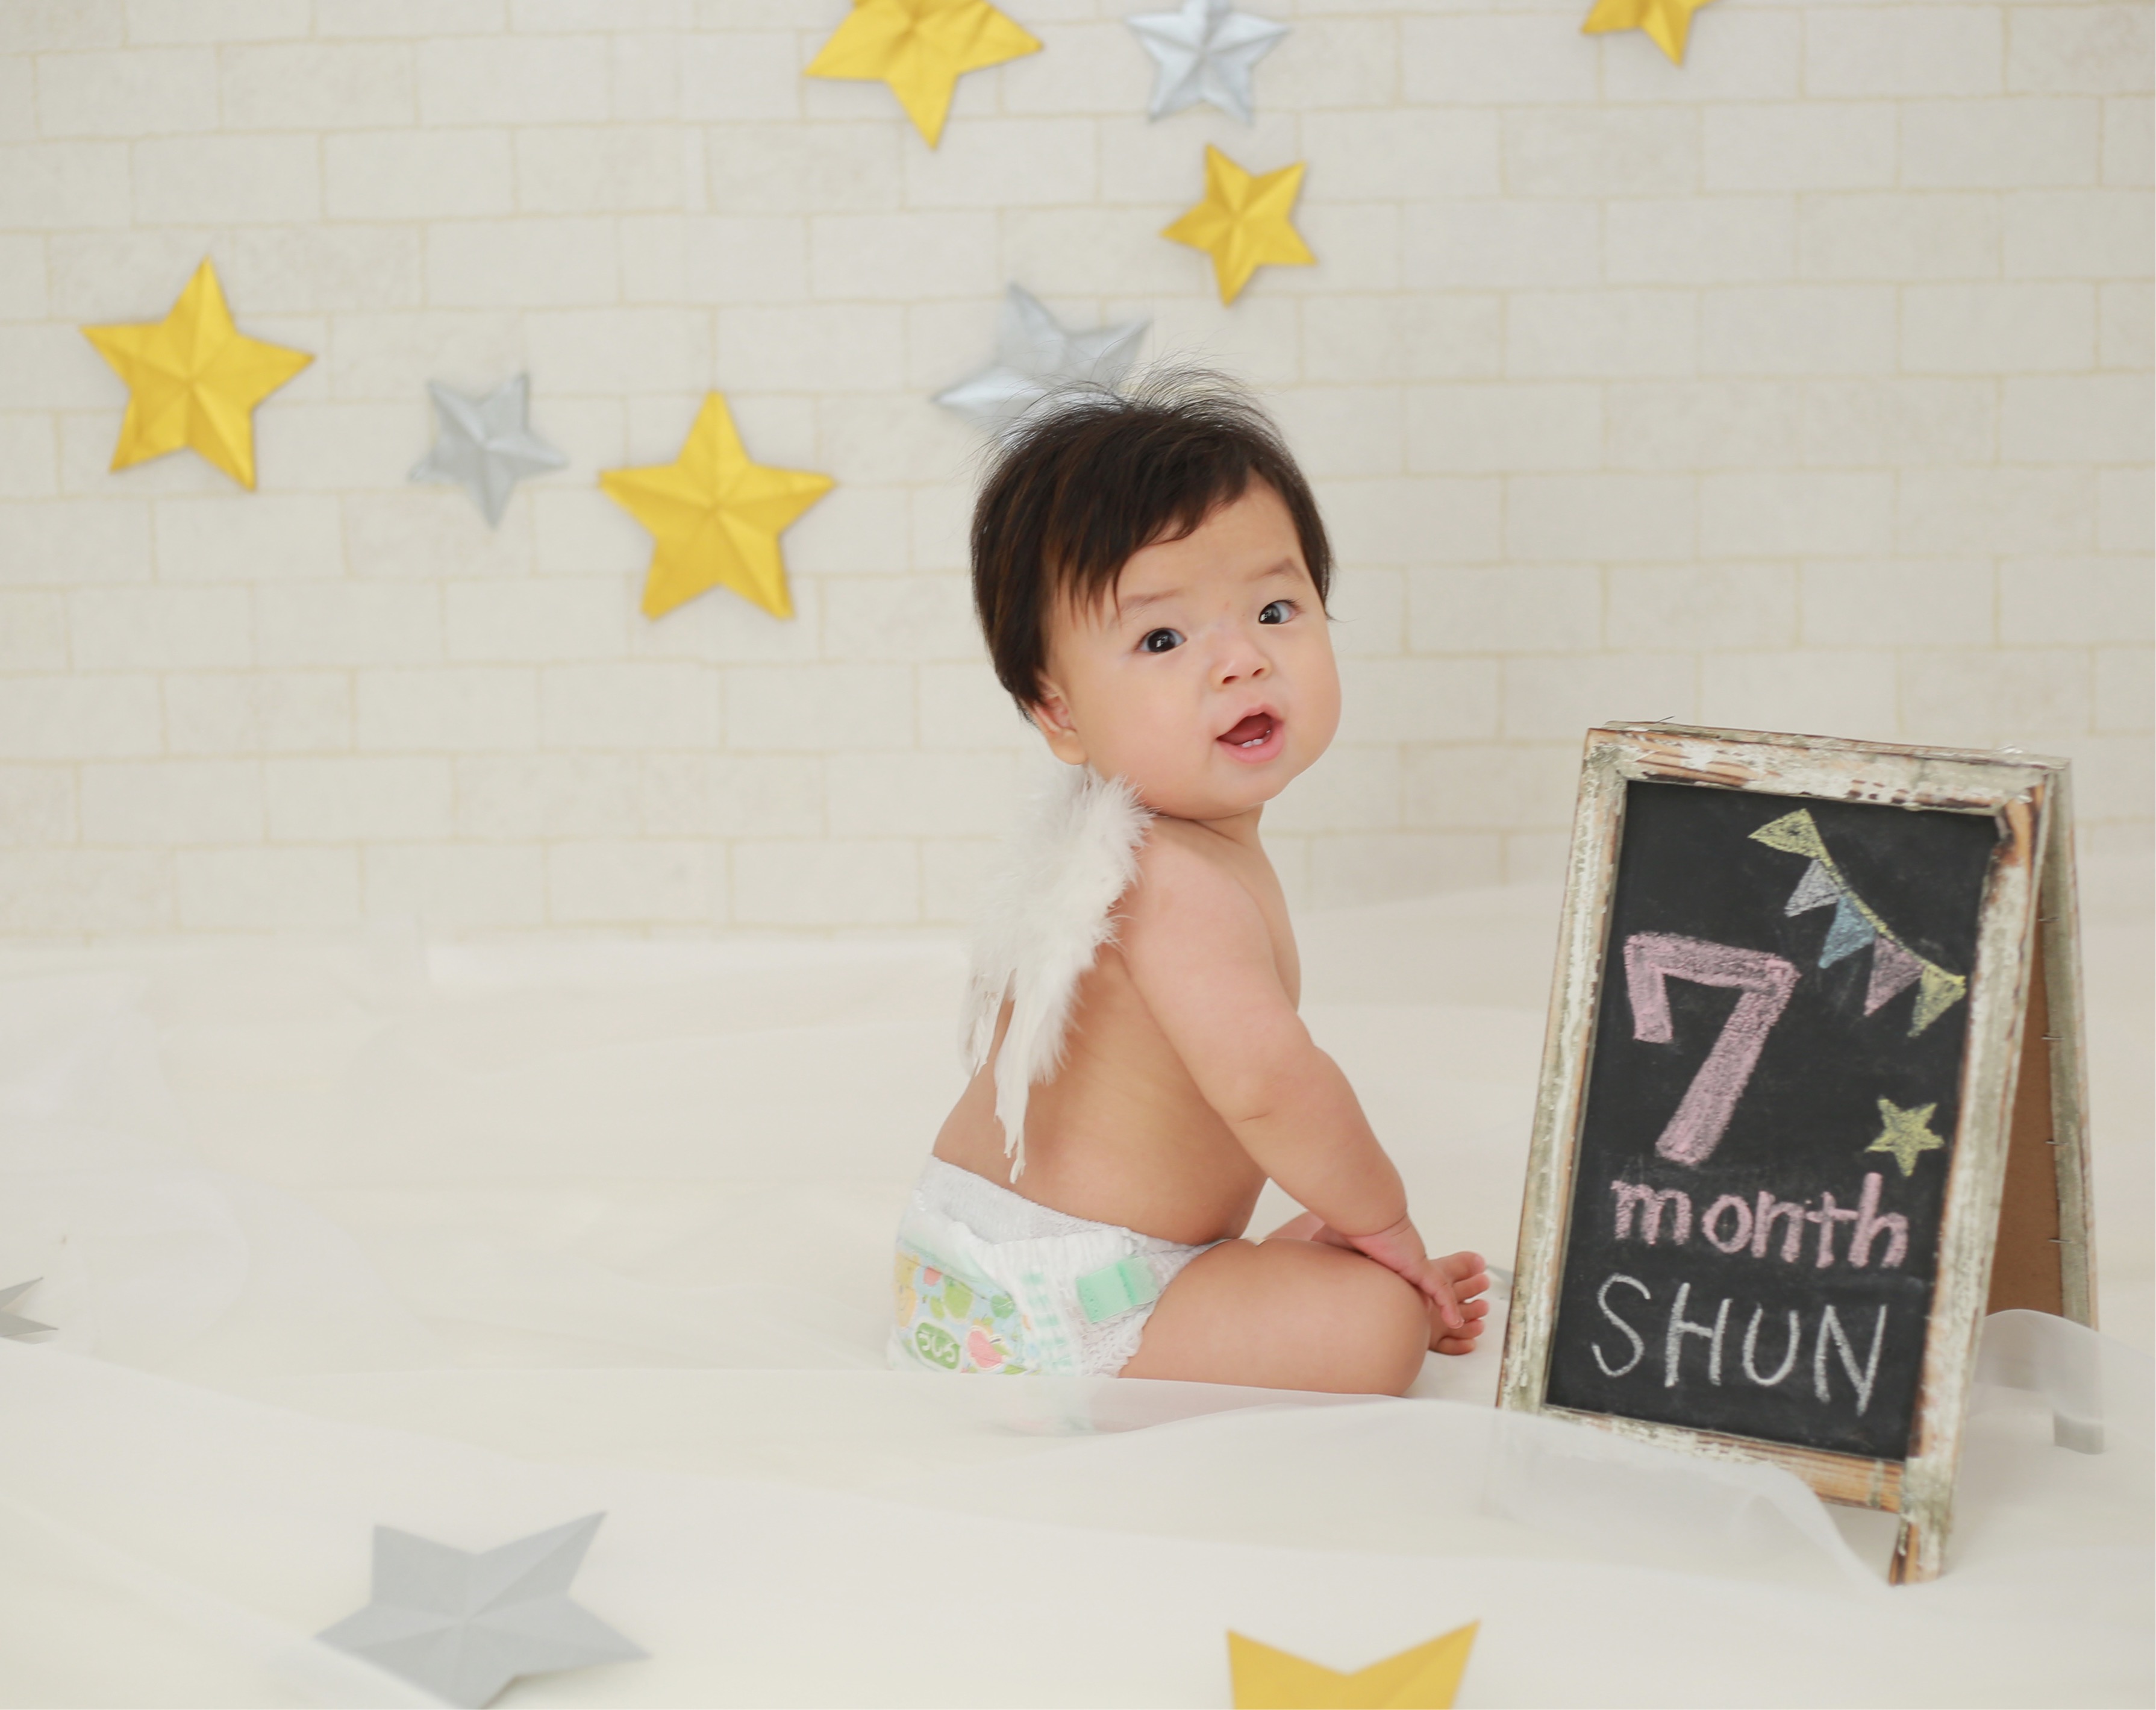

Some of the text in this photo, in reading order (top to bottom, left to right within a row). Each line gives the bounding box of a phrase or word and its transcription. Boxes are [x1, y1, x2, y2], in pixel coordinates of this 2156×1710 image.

[1623, 932, 1802, 1165] 7
[1610, 1172, 1908, 1268] month
[1591, 1272, 1887, 1416] SHUN
